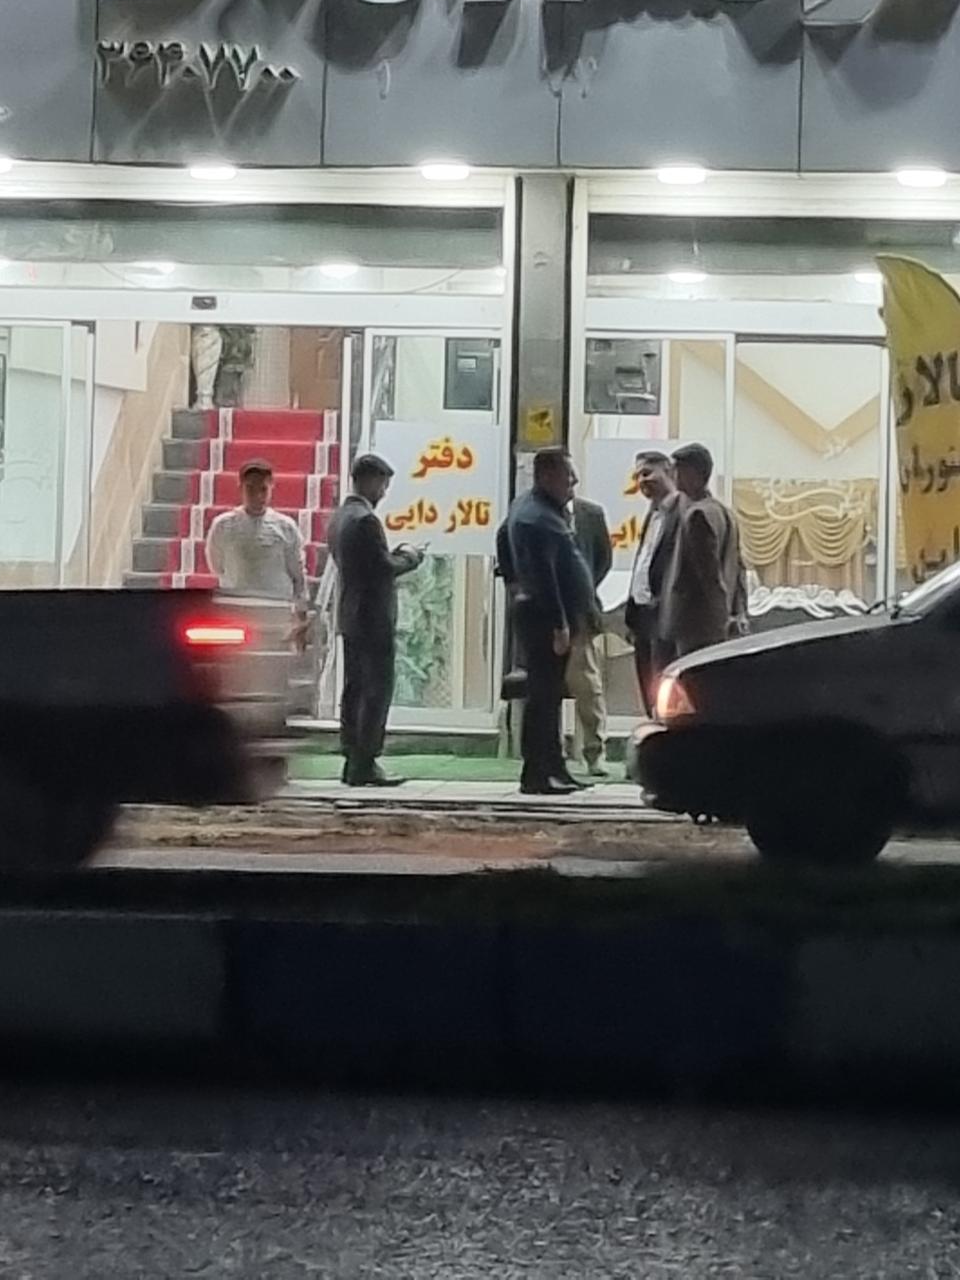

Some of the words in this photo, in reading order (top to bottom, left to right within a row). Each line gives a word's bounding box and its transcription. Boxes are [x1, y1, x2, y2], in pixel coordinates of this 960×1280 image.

[410, 435, 474, 480] دفتر
[384, 498, 439, 532] دایی
[442, 498, 492, 535] تالار
